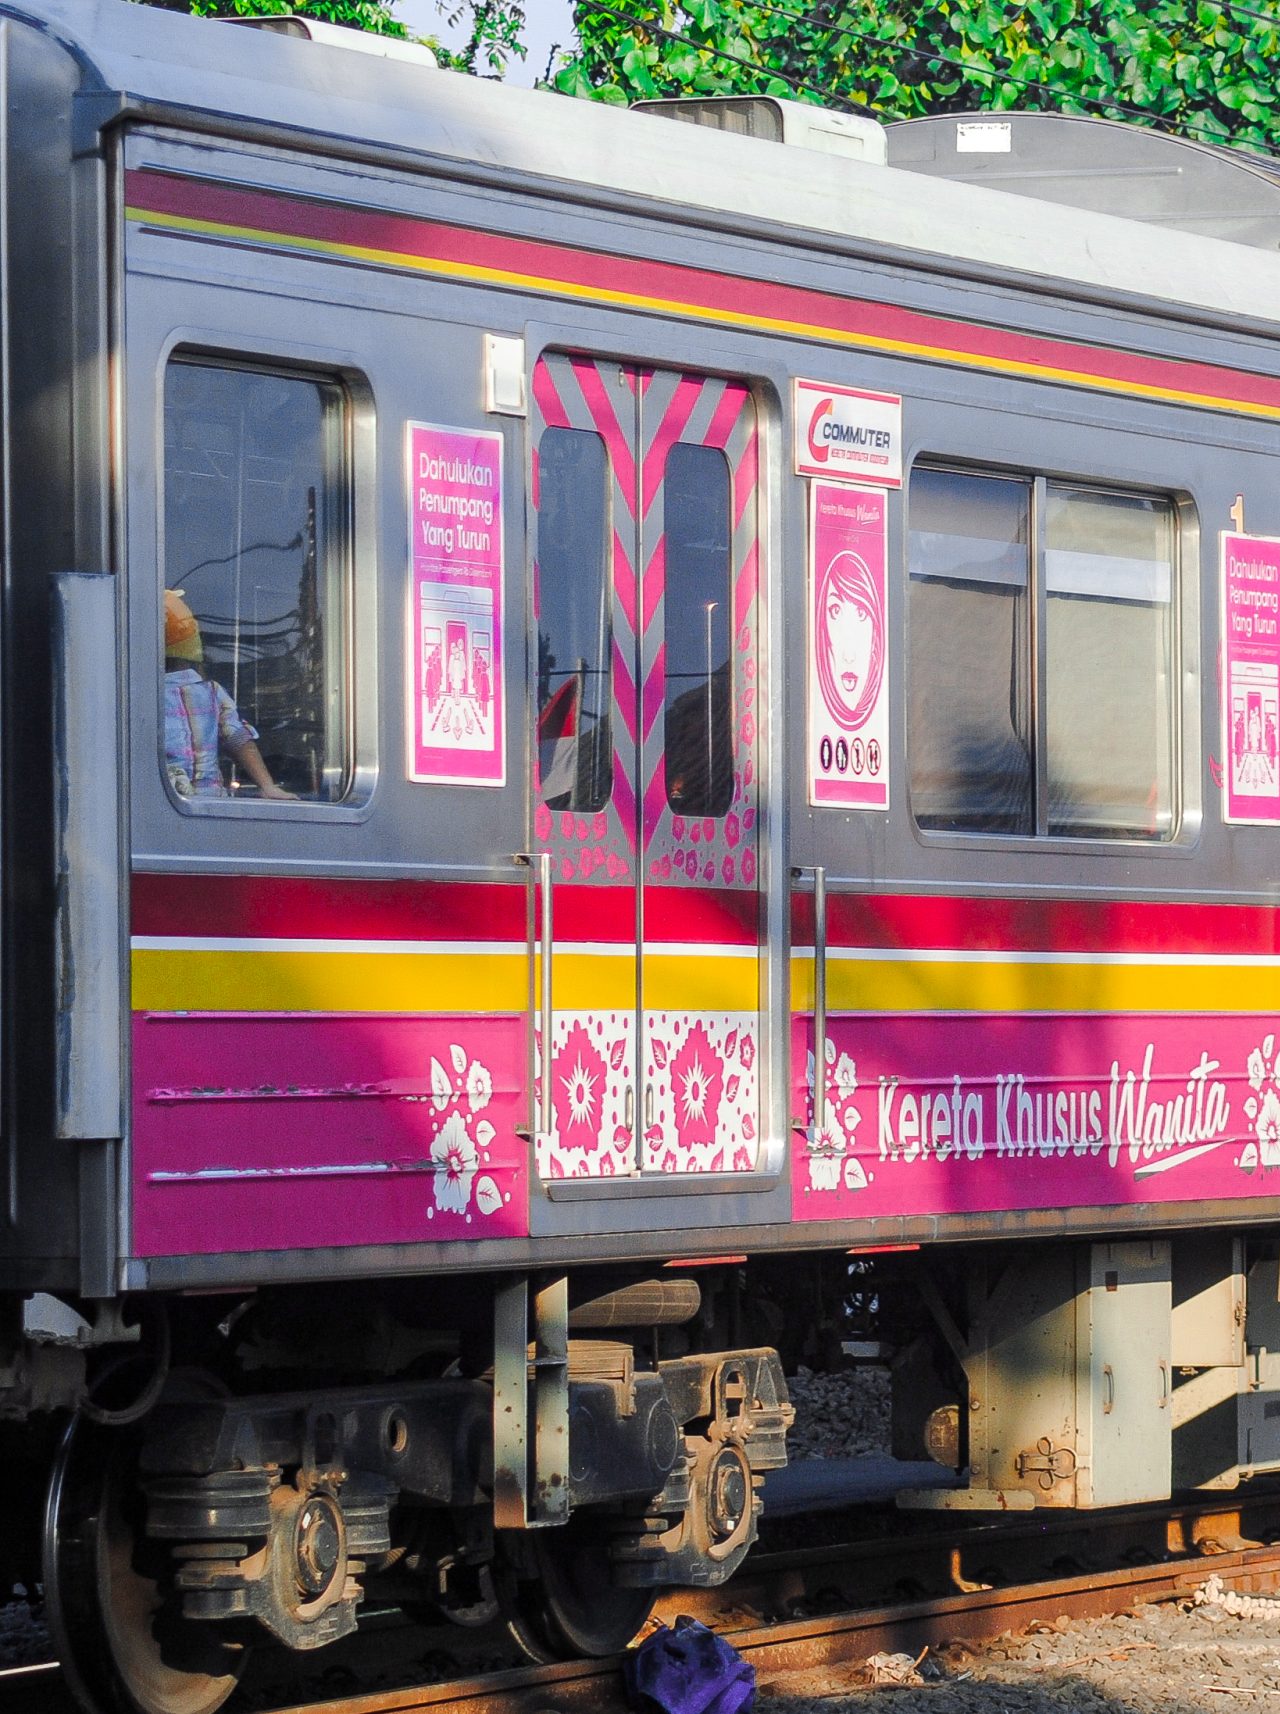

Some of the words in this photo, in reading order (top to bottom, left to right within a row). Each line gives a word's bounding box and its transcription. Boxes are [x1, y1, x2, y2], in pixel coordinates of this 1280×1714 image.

[823, 422, 891, 449] COMMUTER
[419, 452, 493, 487] Dahulukan
[419, 487, 493, 525] Penumpang
[422, 520, 454, 553] Yang
[456, 524, 491, 552] Turun
[1229, 556, 1279, 583] Dahulukan
[1229, 585, 1279, 613] Penumpang
[1231, 612, 1252, 638] Yang
[1253, 614, 1277, 635] Turun
[878, 1074, 983, 1162] Kereta
[996, 1073, 1104, 1159] Khusus
[1107, 1043, 1231, 1170] Wanita
